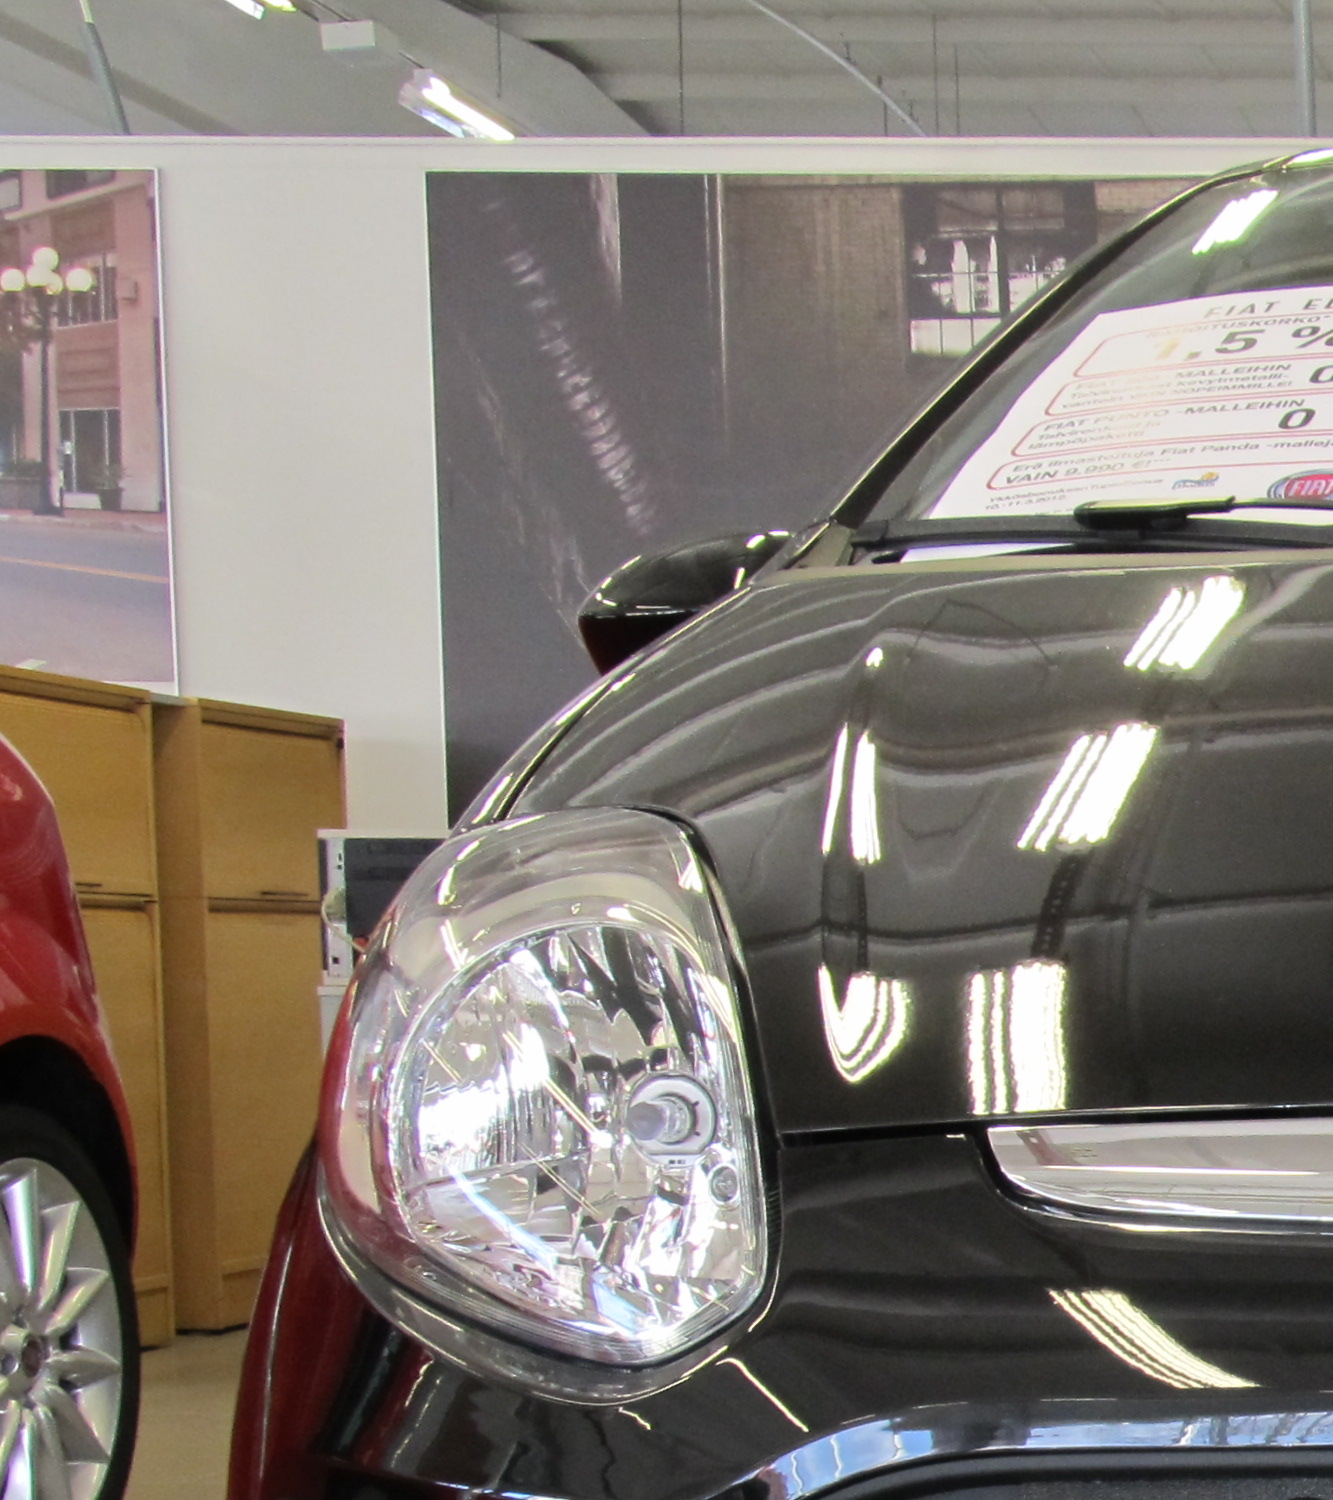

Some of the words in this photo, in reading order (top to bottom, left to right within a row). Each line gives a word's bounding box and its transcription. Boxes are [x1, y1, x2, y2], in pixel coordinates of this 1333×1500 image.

[1204, 300, 1281, 319] FIAT
[1277, 407, 1317, 430] 0
[1200, 441, 1260, 454] Panda
[1005, 470, 1060, 485] VAIN
